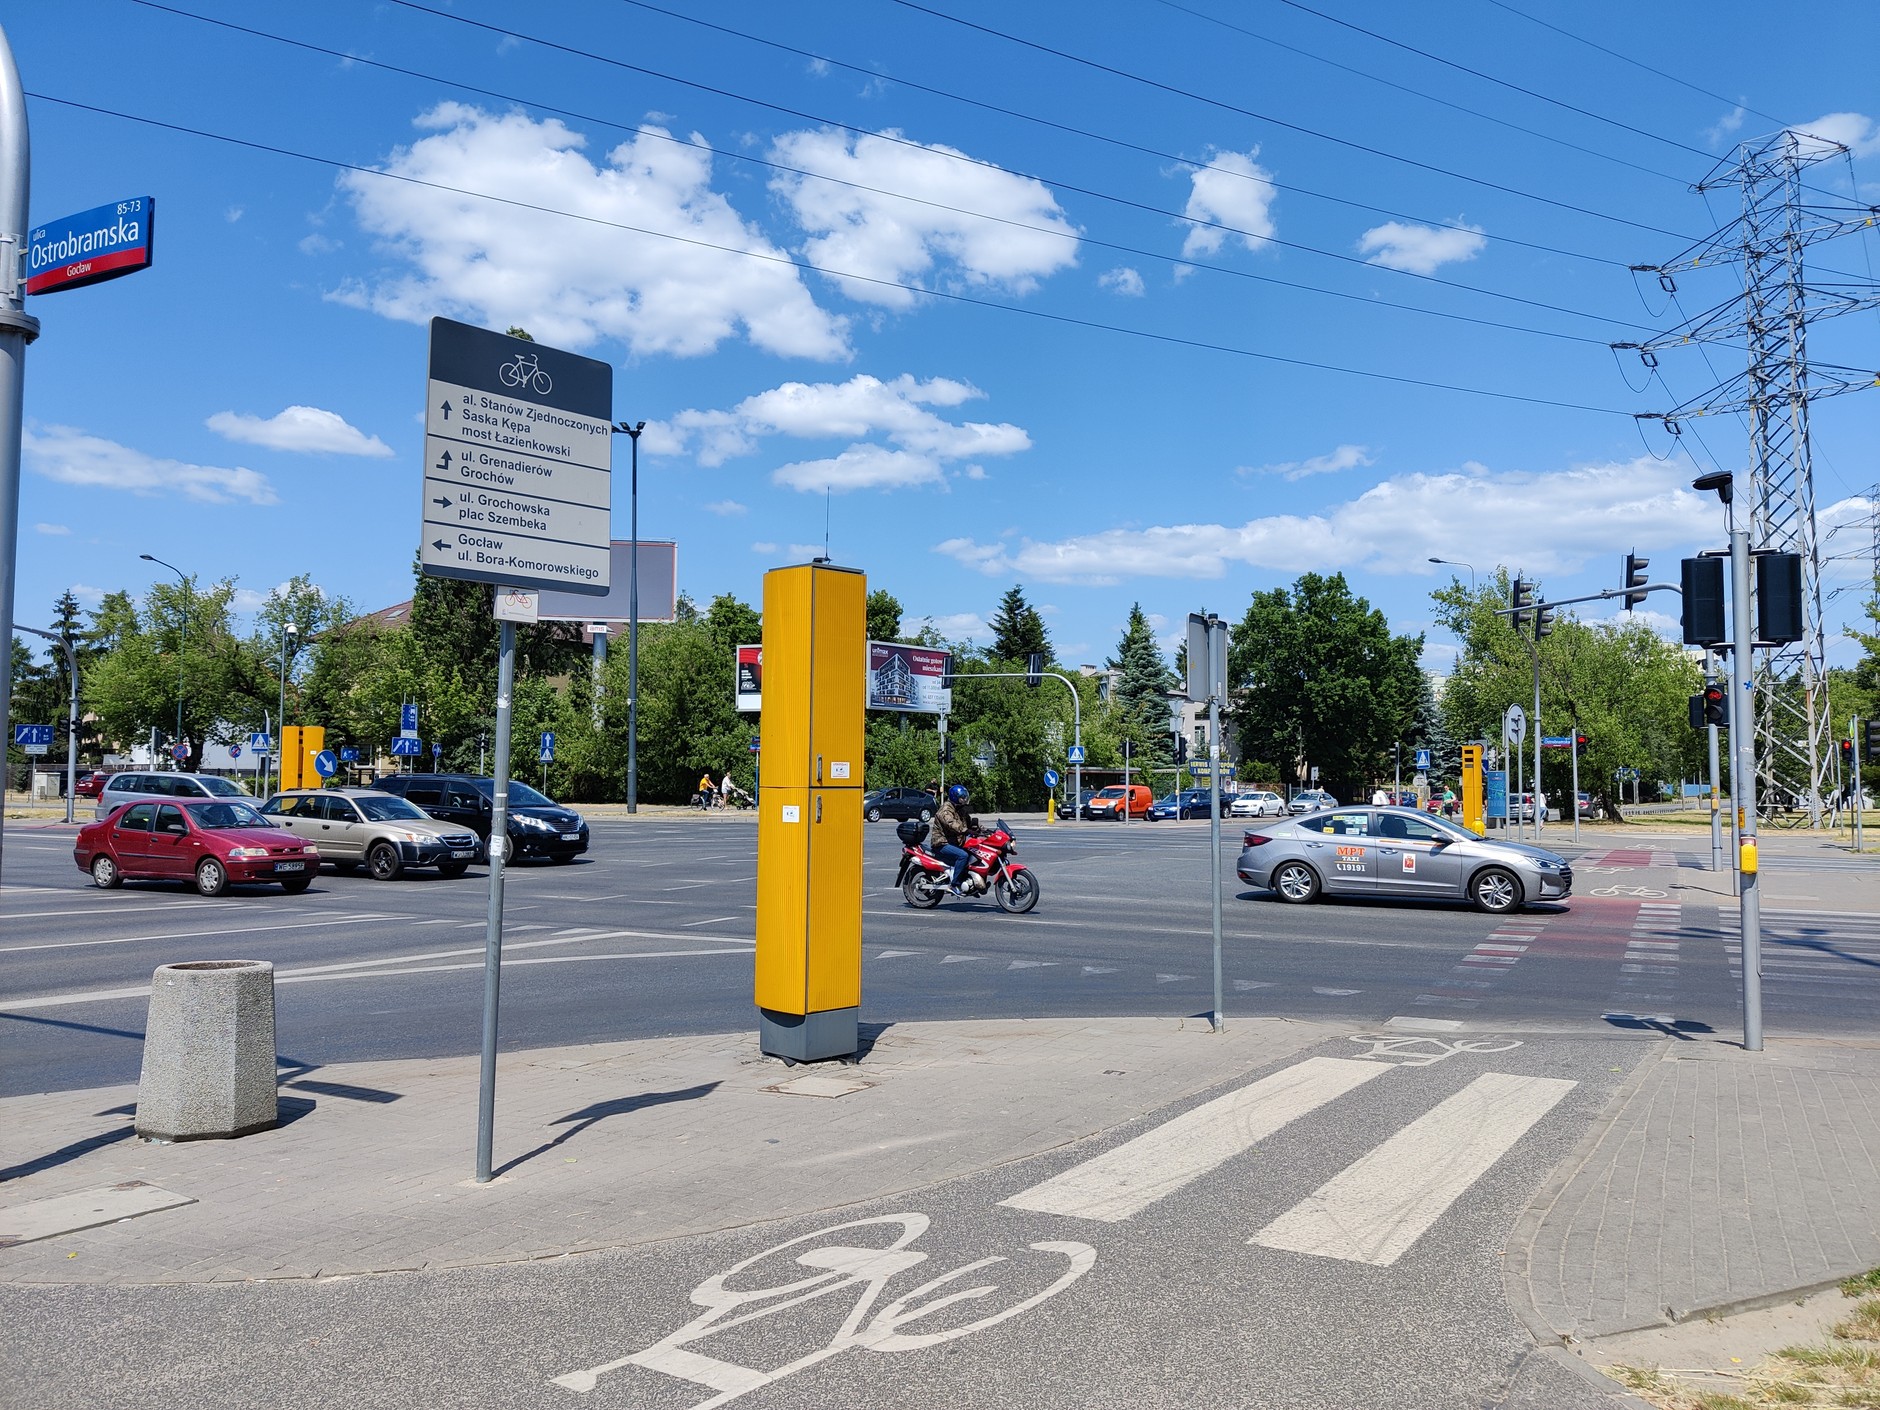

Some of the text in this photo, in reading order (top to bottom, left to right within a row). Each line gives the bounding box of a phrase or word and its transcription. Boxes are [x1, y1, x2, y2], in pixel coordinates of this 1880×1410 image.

[117, 200, 141, 215] 85-73
[31, 217, 139, 269] Ostrobramska
[33, 229, 46, 242] ulica
[66, 262, 91, 277] Gocław
[462, 409, 531, 434] Saska Kępa
[463, 394, 608, 436] al. Stanów Zjednoczonych
[462, 427, 571, 457] most Łazienkowski
[460, 466, 515, 485] Grochów
[461, 451, 553, 477] ul. Grenadierów
[460, 492, 550, 516] ul. Grochowska
[459, 508, 547, 531] plac Szembeka
[458, 533, 503, 550] Gocław
[458, 550, 599, 579] ul. Bora-Komorowskiego
[1337, 847, 1366, 856] MPT
[1342, 864, 1366, 872] 19191
